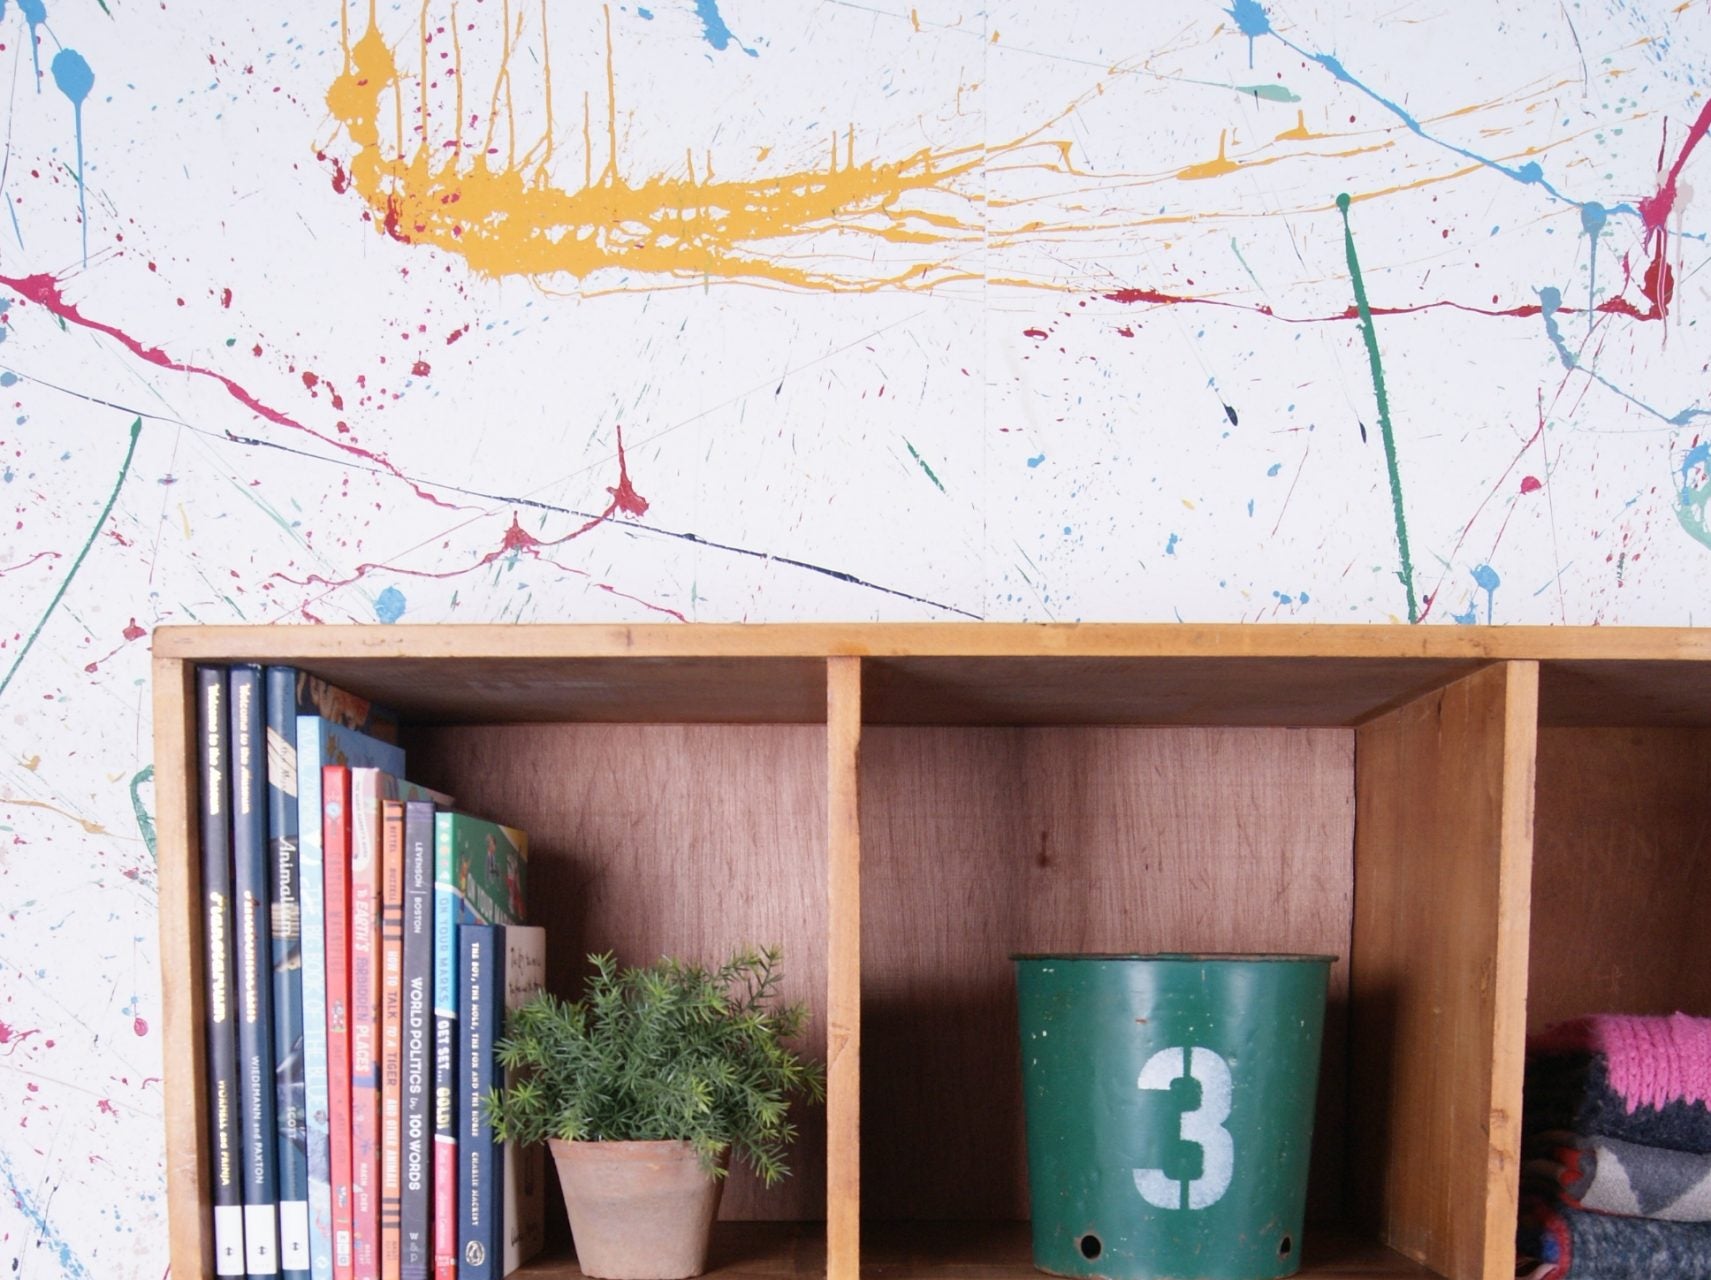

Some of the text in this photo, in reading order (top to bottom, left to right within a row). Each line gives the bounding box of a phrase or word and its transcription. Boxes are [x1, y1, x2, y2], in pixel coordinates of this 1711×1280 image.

[279, 837, 297, 939] Animalium
[413, 842, 424, 933] LEVENSON BOSTON
[303, 925, 322, 947] BIG
[354, 900, 371, 953] EARTH'S
[471, 943, 480, 959] THE
[303, 951, 323, 996] BOOK
[386, 992, 399, 1019] TALK
[410, 977, 423, 1027] WORLD
[471, 985, 480, 1000] THE
[305, 1030, 326, 1061] THE
[354, 1025, 371, 1073] PLACES
[437, 1020, 450, 1044] GET
[471, 1033, 480, 1049] THE
[409, 1030, 423, 1094] POLITICS
[471, 1052, 480, 1069] FOX
[471, 1071, 480, 1089] AND
[436, 1087, 450, 1129] GOLD!
[471, 1092, 480, 1107] THE
[250, 1056, 264, 1184] WIEDEMANN and PAXTON
[286, 1106, 297, 1139] SCOTT
[409, 1114, 422, 1138] 100
[1132, 1046, 1234, 1210] 3
[409, 1140, 422, 1190] WORDS
[471, 1152, 480, 1187] CHARLIE
